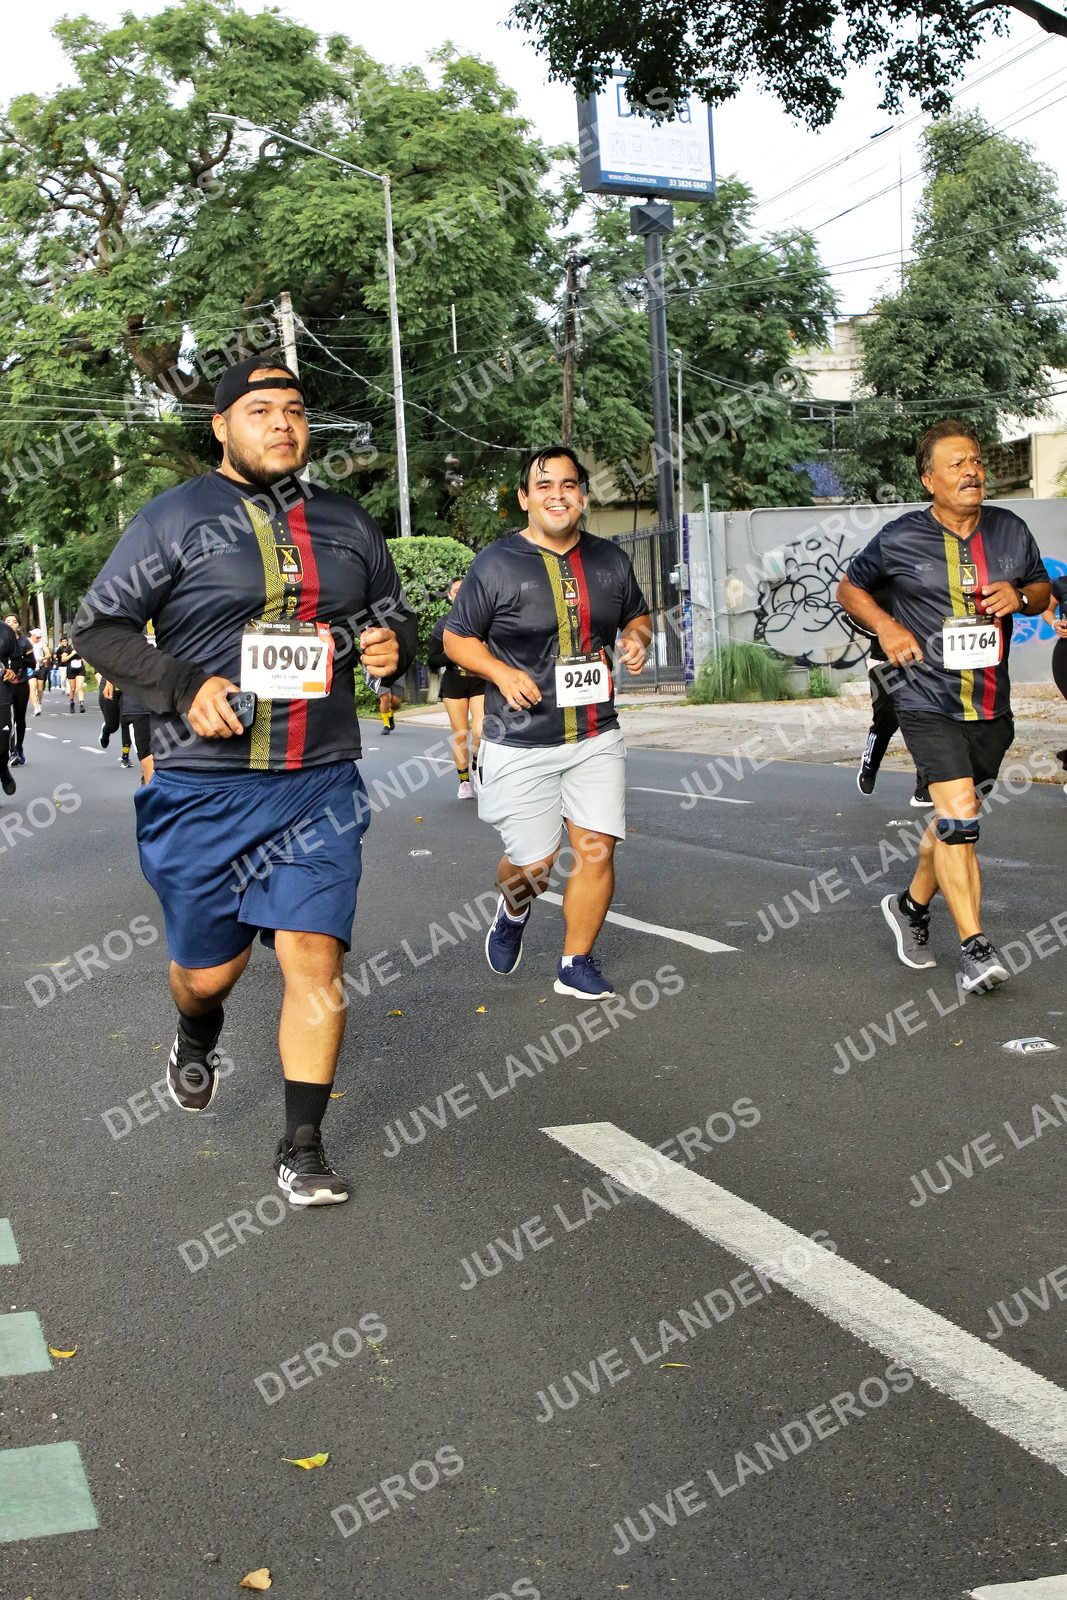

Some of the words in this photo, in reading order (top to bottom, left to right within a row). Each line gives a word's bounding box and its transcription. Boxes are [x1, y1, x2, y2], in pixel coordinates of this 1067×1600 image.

[787, 534, 844, 557] TOY
[947, 631, 997, 651] 11764
[247, 645, 323, 670] 10907
[564, 669, 601, 689] 9240
